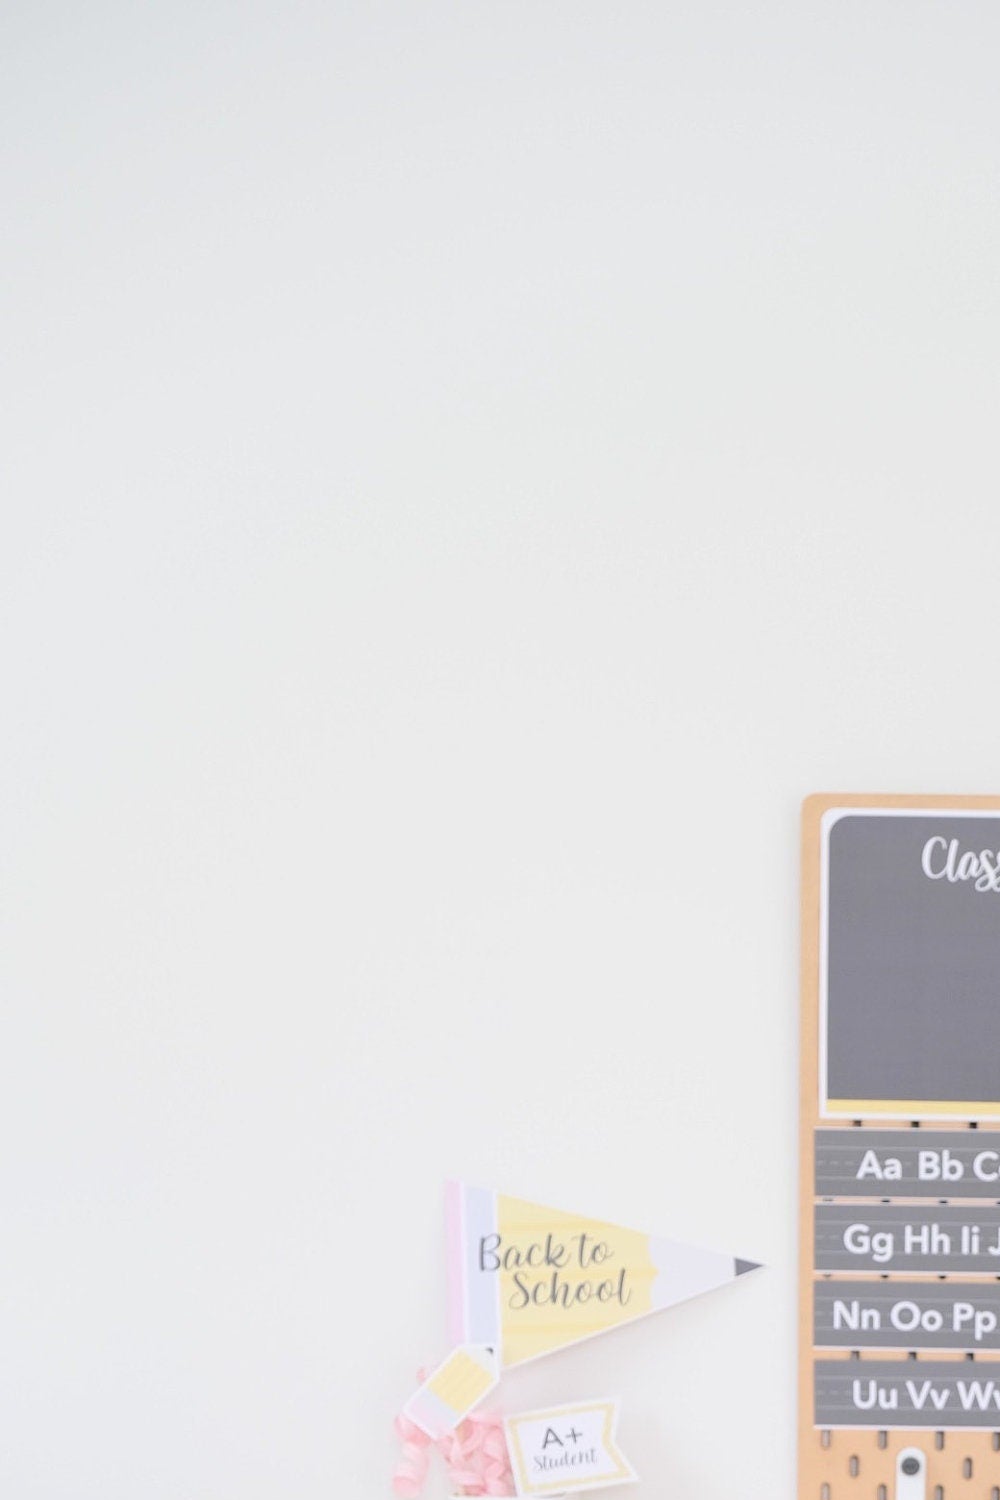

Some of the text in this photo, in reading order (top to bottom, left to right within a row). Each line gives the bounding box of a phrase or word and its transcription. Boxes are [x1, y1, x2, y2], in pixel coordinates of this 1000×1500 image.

[856, 1150, 902, 1181] Aa
[918, 1150, 964, 1182] Bb
[479, 1232, 614, 1271] Back to
[843, 1224, 894, 1262] Gg
[904, 1225, 950, 1256] Hh
[961, 1225, 980, 1256] Ii
[508, 1268, 631, 1310] School
[833, 1300, 881, 1331] Nn
[890, 1301, 943, 1332] Oo
[952, 1302, 996, 1340] Pp
[852, 1379, 898, 1410] Uu
[905, 1380, 950, 1410] Vv
[542, 1427, 583, 1449] A+
[533, 1448, 597, 1471] Student
